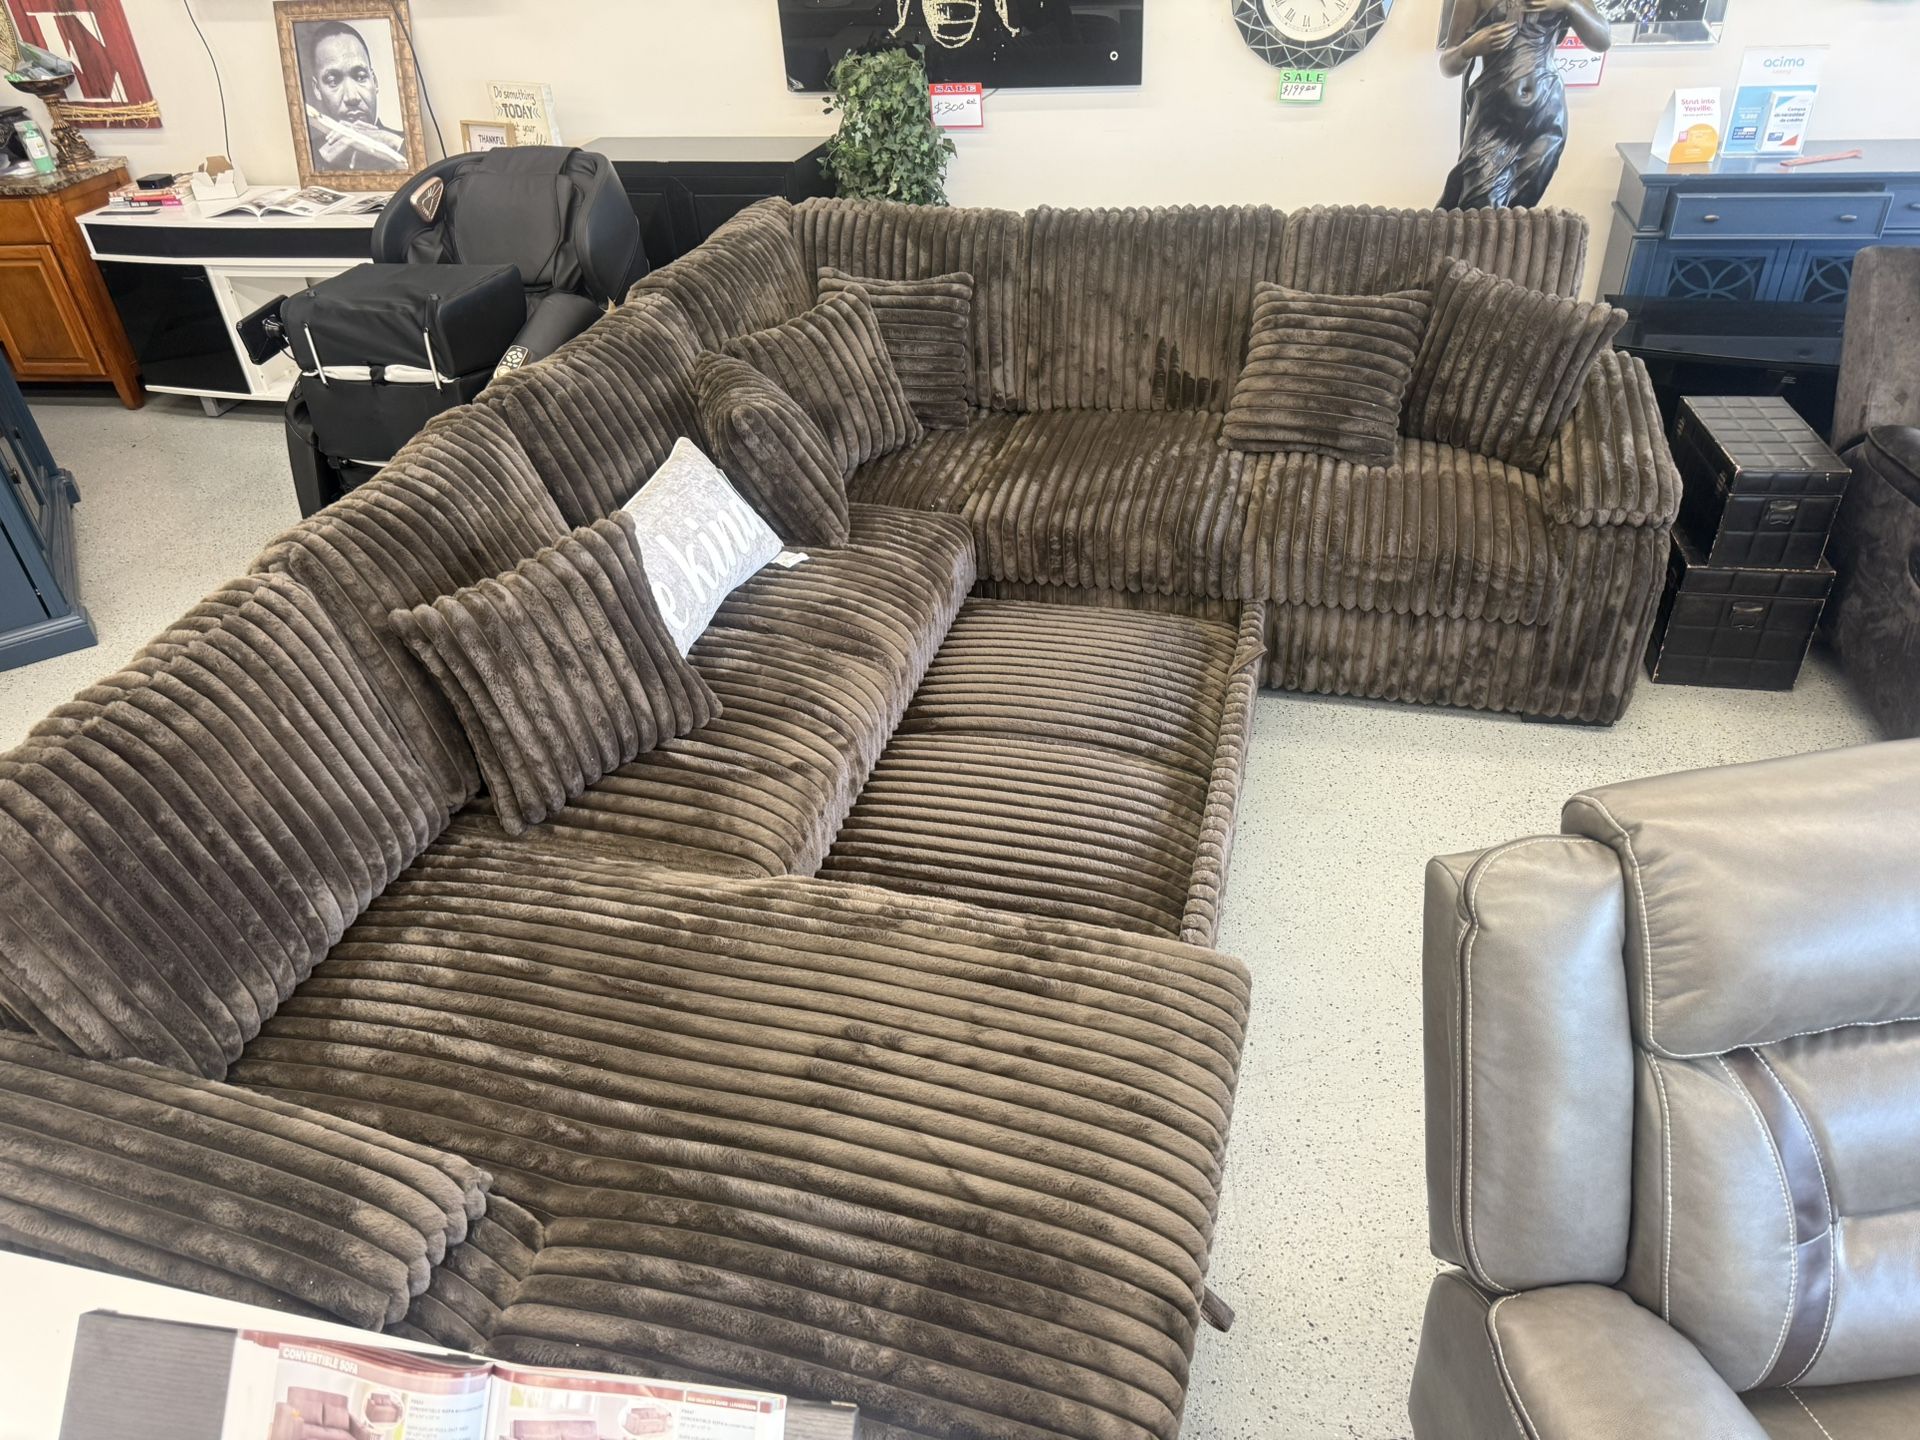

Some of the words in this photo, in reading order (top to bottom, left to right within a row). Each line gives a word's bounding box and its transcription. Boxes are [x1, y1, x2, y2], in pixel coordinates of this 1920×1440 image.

[1763, 56, 1805, 68] acima
[1282, 72, 1324, 83] SALE
[935, 85, 977, 93] SALE
[493, 86, 502, 98] Do
[503, 89, 536, 106] something
[501, 103, 533, 119] TODAY
[477, 134, 506, 145] THANKFUL
[281, 1346, 341, 1370] CONVERTIBLE
[338, 1358, 360, 1376] SOFA
